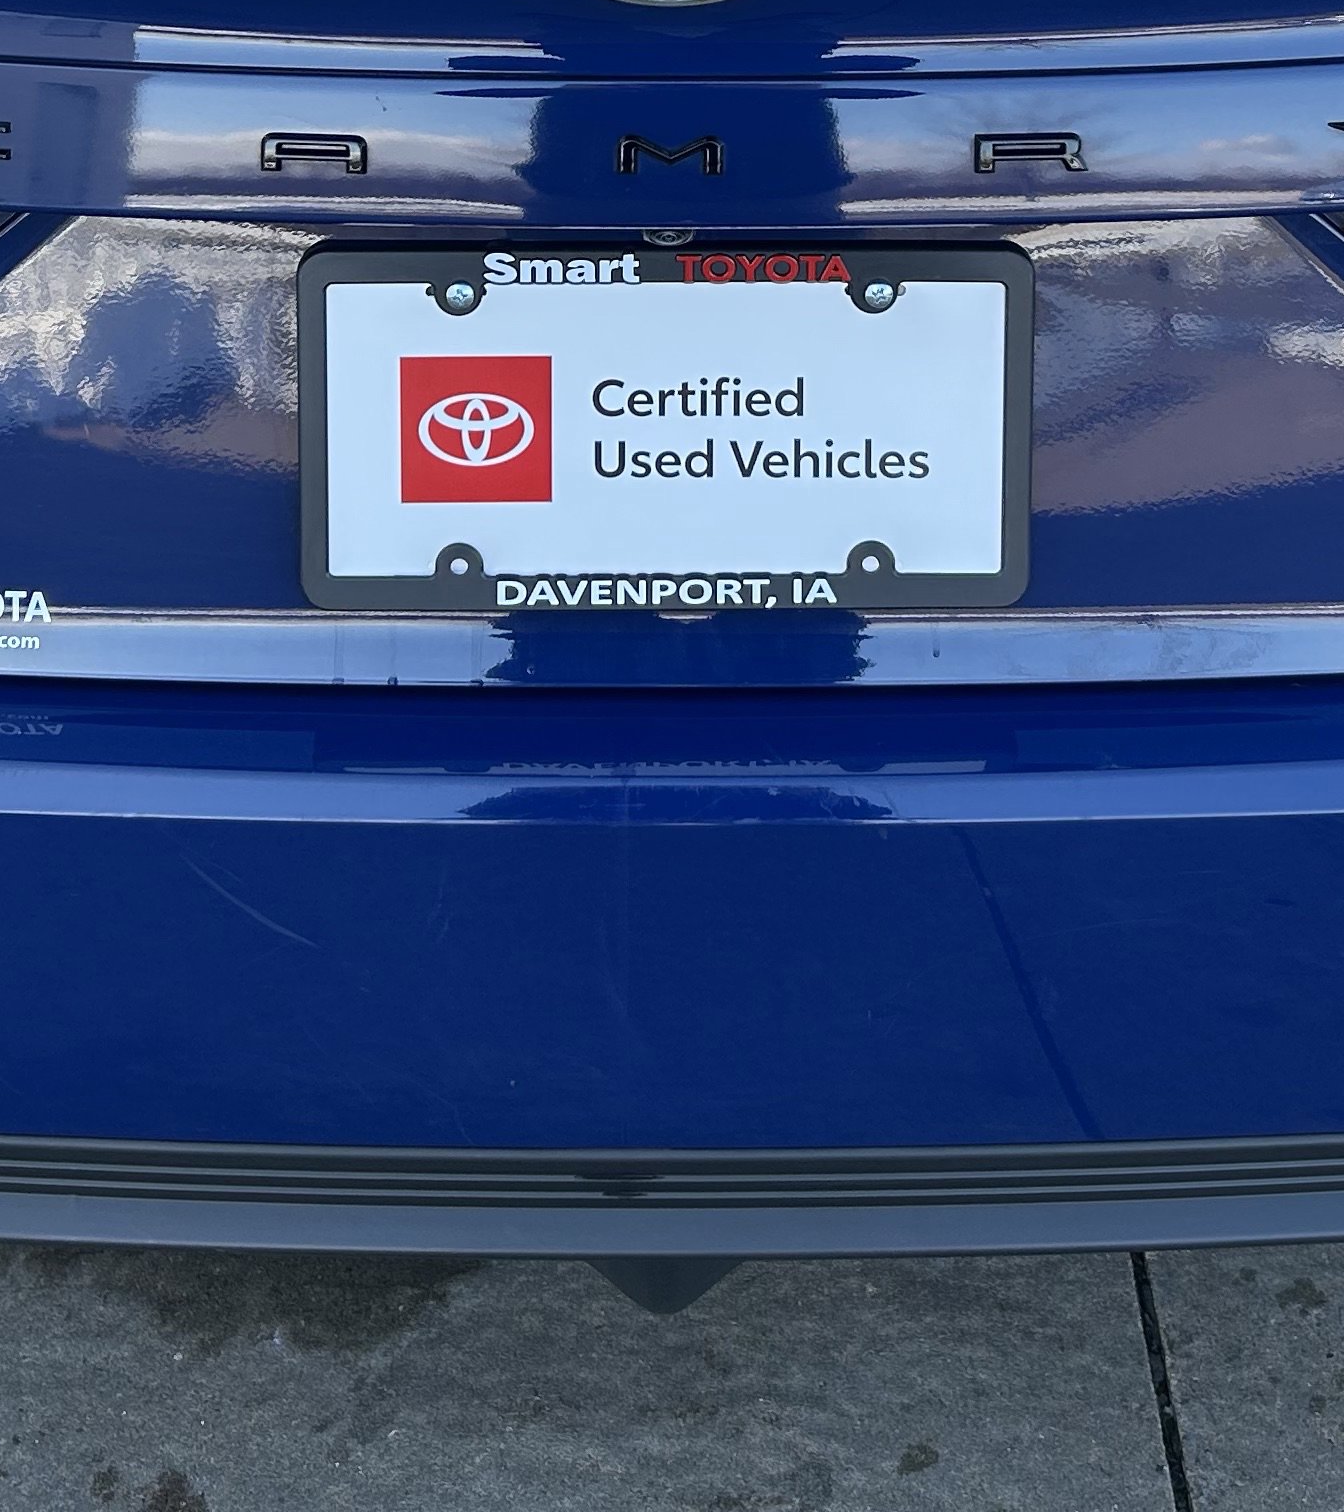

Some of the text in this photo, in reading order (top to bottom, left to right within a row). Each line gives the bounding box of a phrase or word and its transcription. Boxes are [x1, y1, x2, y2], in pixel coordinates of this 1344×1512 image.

[483, 252, 851, 286] Smart TOYOTA
[592, 377, 806, 418] Certified
[593, 439, 931, 479] Used Vehicles
[496, 578, 838, 609] DAVENPORT, IA
